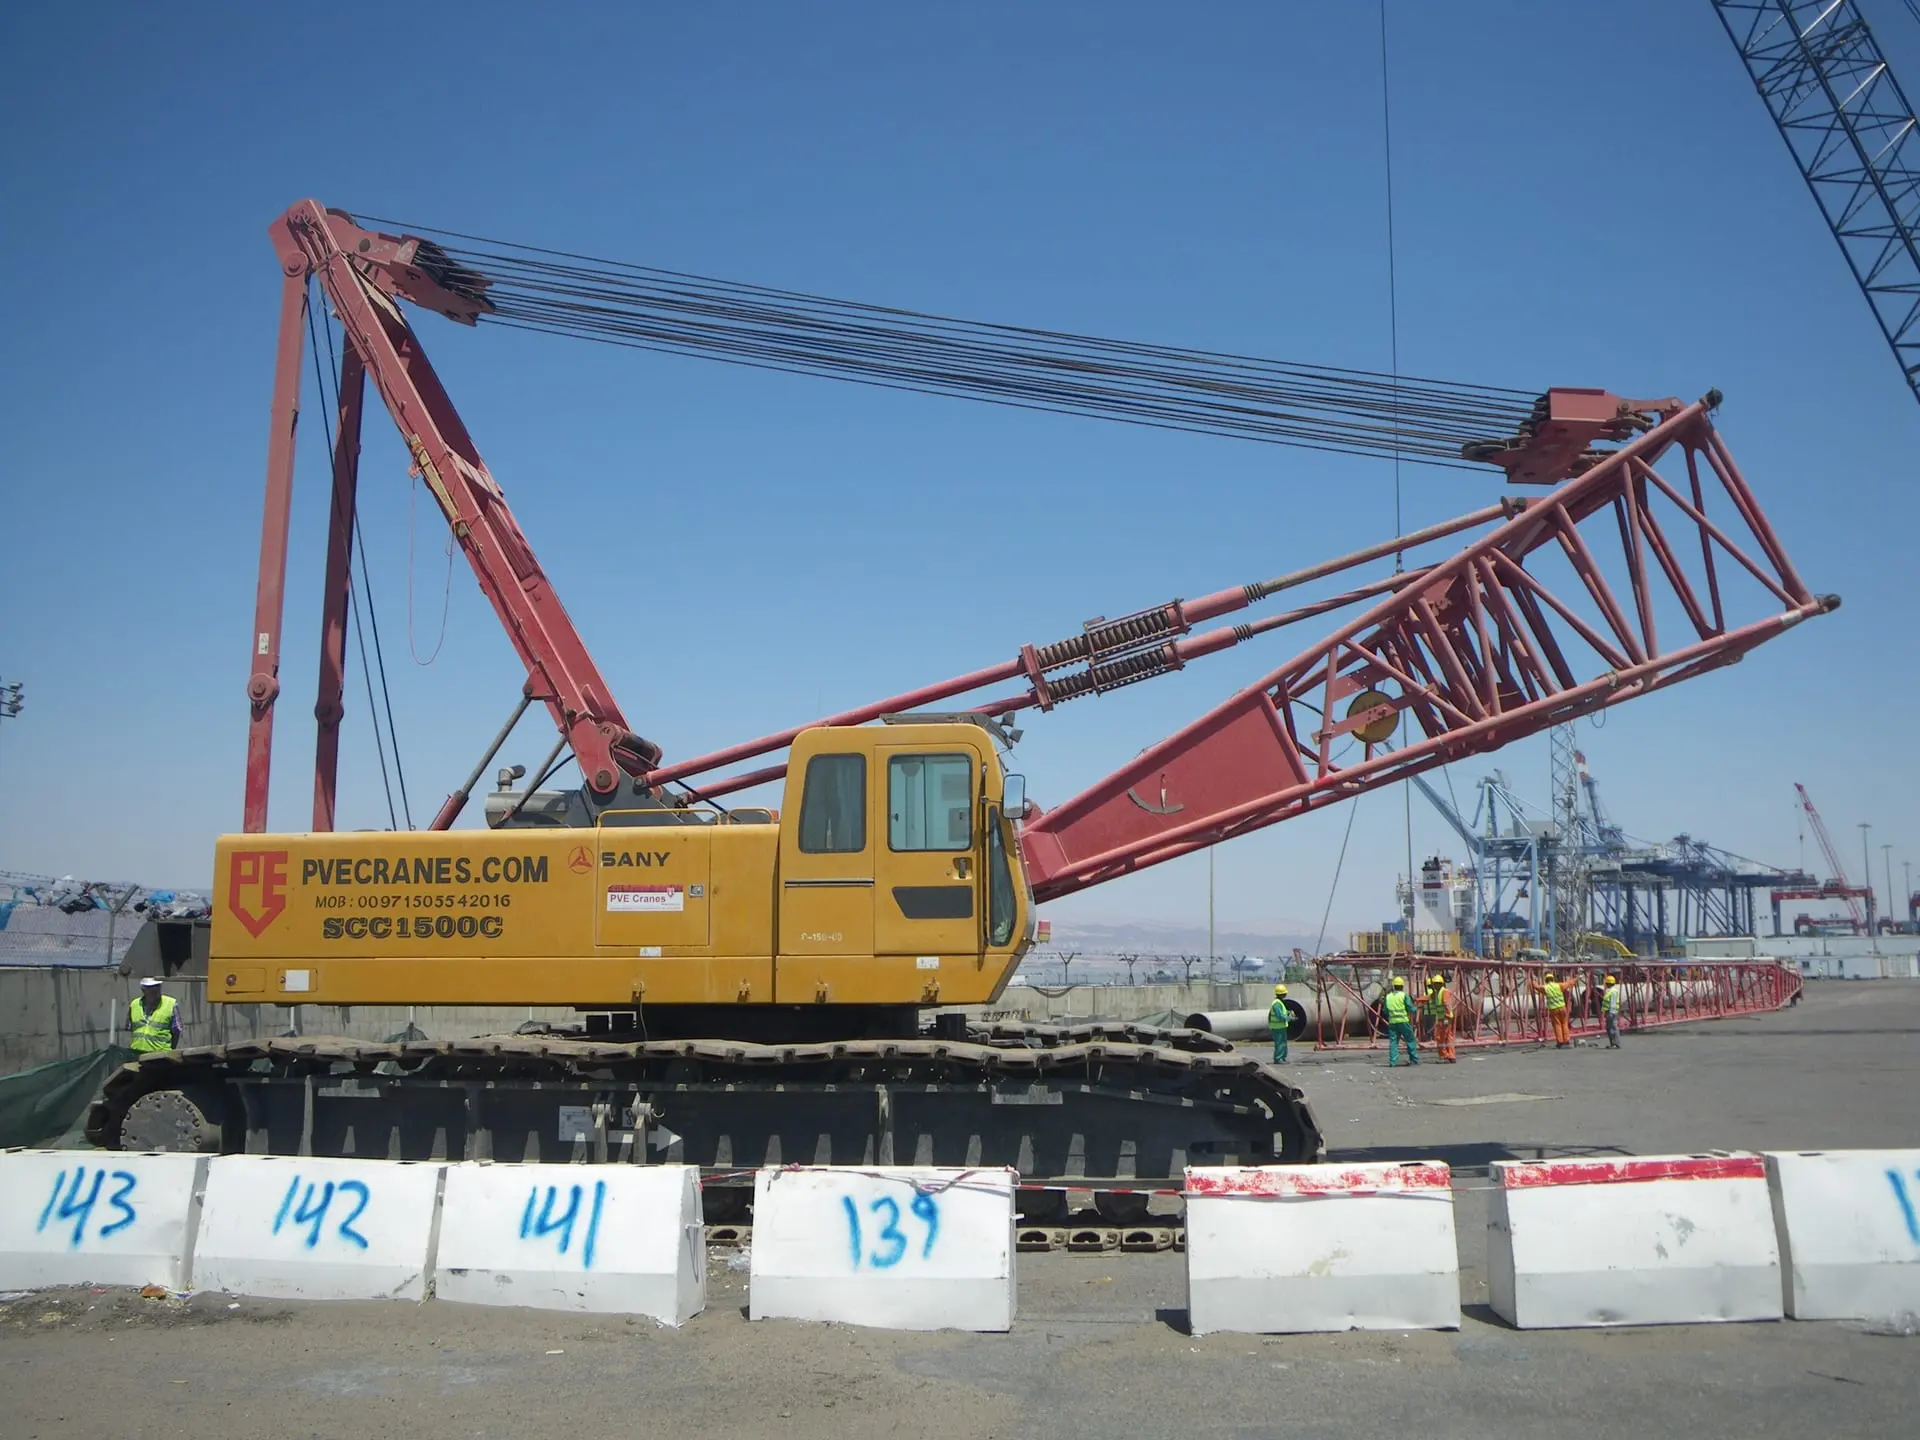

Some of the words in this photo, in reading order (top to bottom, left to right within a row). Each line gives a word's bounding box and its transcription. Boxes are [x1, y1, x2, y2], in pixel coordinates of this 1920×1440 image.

[302, 856, 548, 885] PVECRANES.COM
[601, 851, 671, 867] SANY
[610, 894, 630, 903] PVE
[632, 894, 666, 903] Cranes
[323, 915, 503, 939] SCC1500C
[38, 1167, 136, 1248] 143
[272, 1175, 369, 1249] 142
[519, 1180, 606, 1269] 141
[840, 1186, 941, 1271] 139
